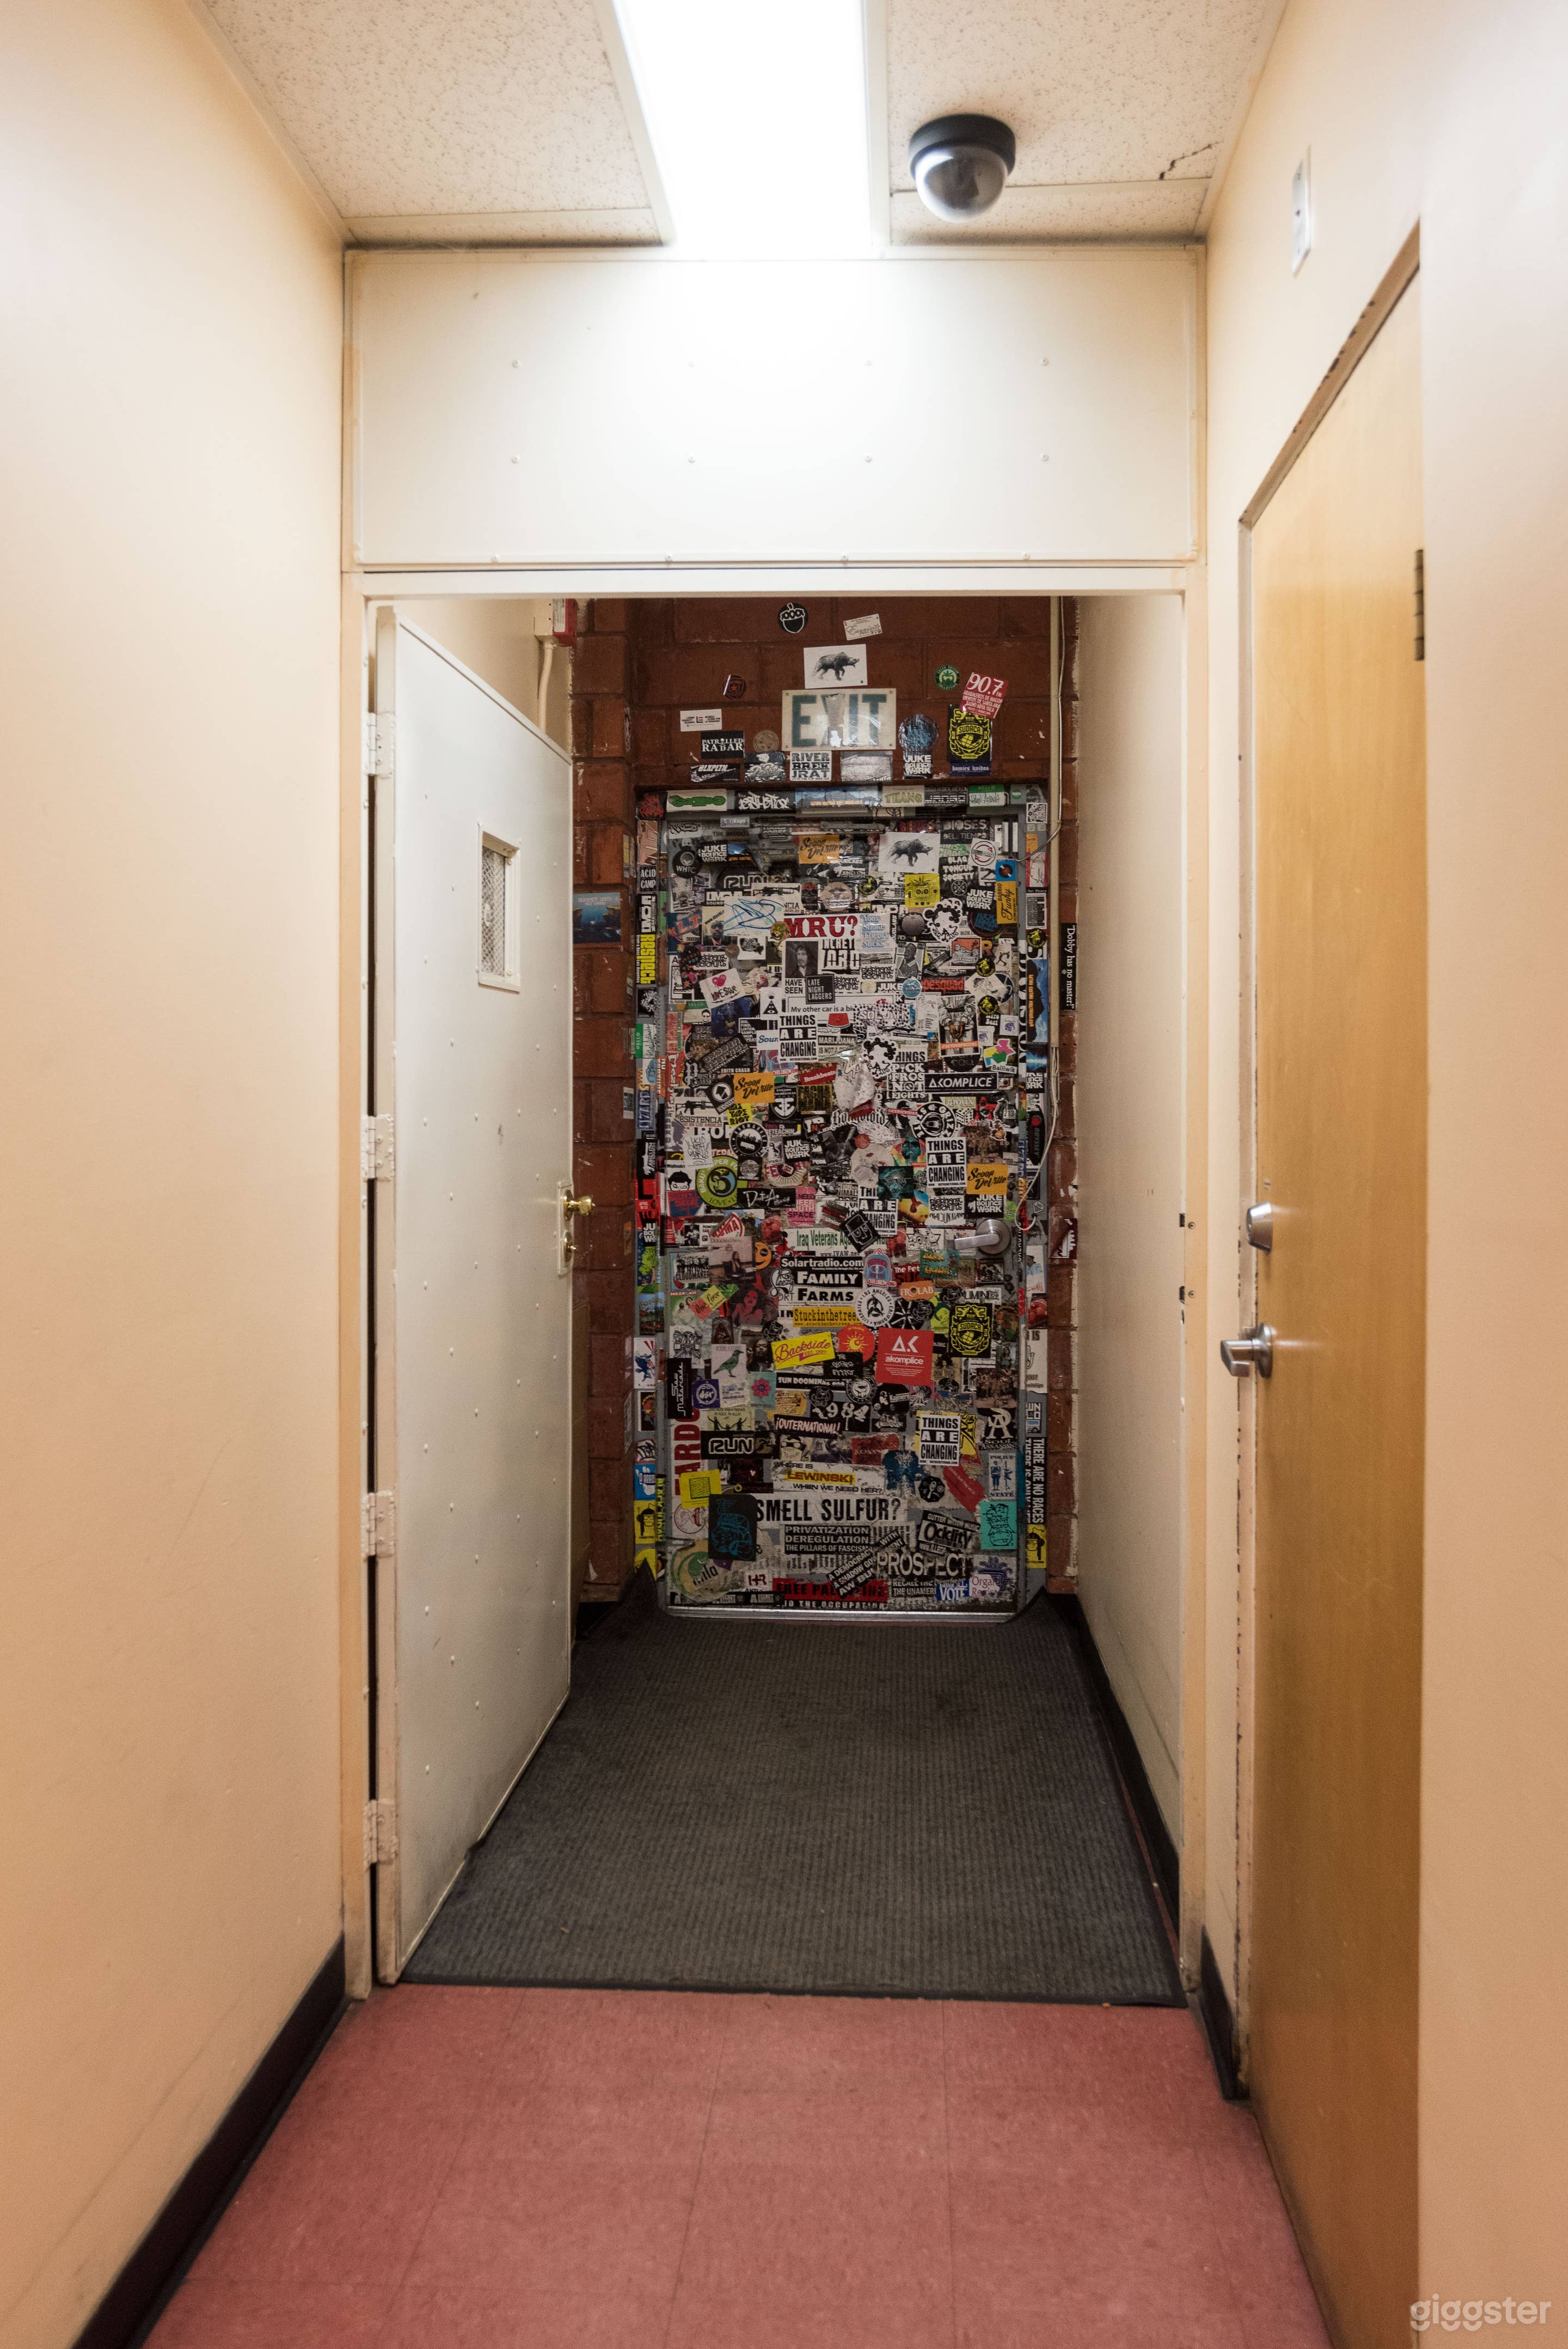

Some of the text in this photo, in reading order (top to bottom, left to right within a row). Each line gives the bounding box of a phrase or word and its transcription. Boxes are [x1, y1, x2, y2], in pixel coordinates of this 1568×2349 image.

[967, 674, 1004, 695] 90.7
[959, 725, 981, 733] SUDACA
[702, 743, 744, 753] RADAR
[791, 753, 830, 762] RIVER
[904, 755, 932, 763] JUKE
[944, 819, 988, 830] DIOSES
[640, 869, 656, 877] ACID
[942, 864, 974, 872] TONGUE
[942, 872, 975, 881] SOCIETY
[640, 879, 656, 889] CAMP
[967, 889, 993, 899] JUKE
[966, 896, 992, 904] BOUNCE
[1001, 889, 1015, 921] Funky
[1064, 925, 1075, 953] "Dobby
[636, 934, 656, 984] Respect
[1067, 969, 1073, 978] no
[808, 992, 832, 1000] LAGGERS
[1066, 981, 1075, 1009] master!"
[780, 1015, 816, 1026] THINGS
[780, 1028, 816, 1039] ARE
[818, 1036, 855, 1044] MARIJUANA
[780, 1042, 816, 1057] CHANGING
[895, 1051, 926, 1062] HINGS
[992, 1065, 1016, 1073] Bailiwik
[804, 1070, 836, 1082] Breakbeats
[730, 1116, 750, 1125] RIOT
[785, 1144, 810, 1153] BOUNCE
[928, 1140, 964, 1151] THINGS
[928, 1153, 965, 1164] ARE
[928, 1167, 965, 1182] CHANGING
[967, 1167, 995, 1182] Scoop
[860, 1186, 877, 1197] THI
[860, 1200, 896, 1210] ARE
[797, 1229, 838, 1250] Iraq Veterans
[781, 1258, 864, 1267] Solartradio.com
[797, 1271, 858, 1284] FAMILY
[798, 1288, 854, 1301] FARMS
[862, 1289, 891, 1302] LOS ANGELES
[775, 1339, 831, 1362] Backside
[885, 1356, 923, 1365] akomplice
[775, 1417, 841, 1435] ¡OUTERNATIONAL!
[922, 1417, 958, 1428] THINGS
[921, 1432, 959, 1441] ARE
[709, 1437, 755, 1454] RUN
[921, 1444, 958, 1460] CHANGING
[787, 1472, 854, 1483] LEWINSKI
[1032, 1438, 1045, 1523] THERE ARE NO RACES
[756, 1498, 901, 1521] SMELL SULFUR?
[927, 1513, 946, 1523] GUTTER
[785, 1526, 869, 1534] PRIVATIZATION
[785, 1535, 869, 1544] DEREGULATION
[834, 1547, 873, 1576] DEMOCRACY
[879, 1531, 898, 1546] WITH
[877, 1552, 973, 1576] PROSPECT
[834, 1563, 864, 1589] A SHADOW
[938, 1587, 966, 1601] VOTE
